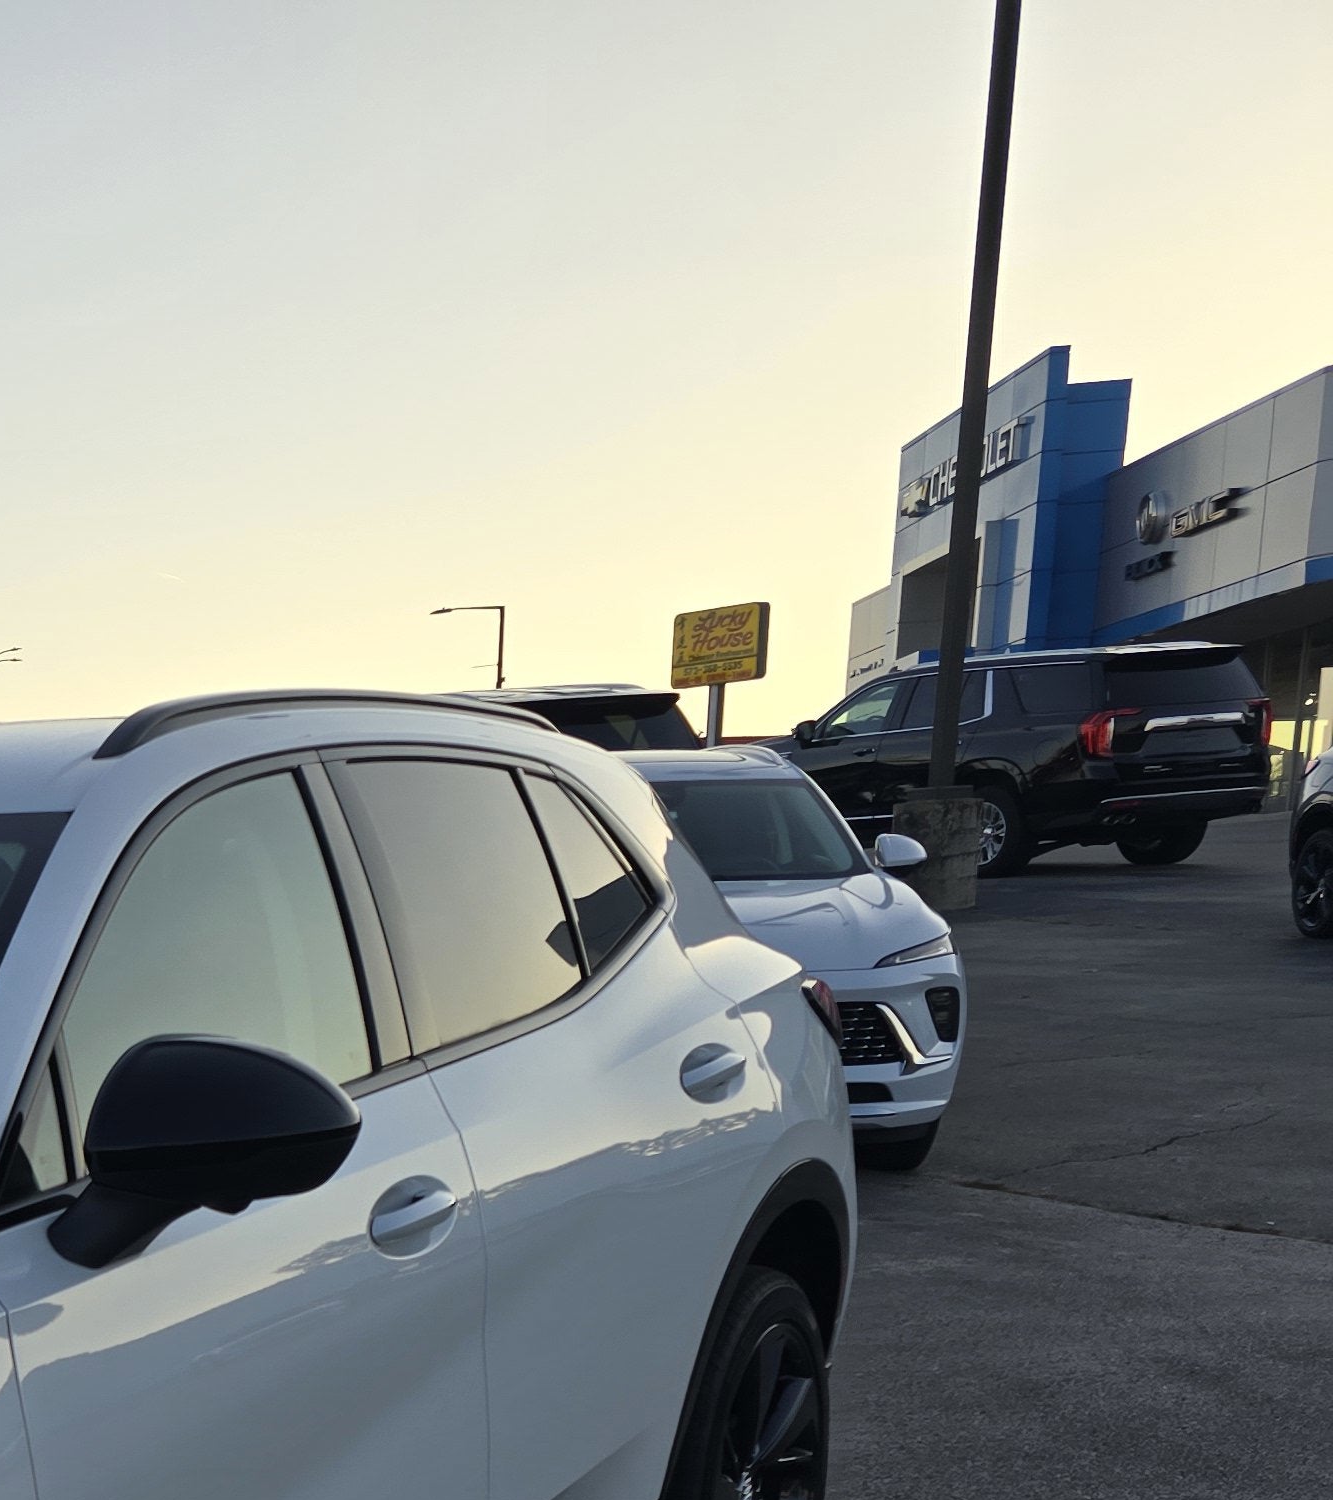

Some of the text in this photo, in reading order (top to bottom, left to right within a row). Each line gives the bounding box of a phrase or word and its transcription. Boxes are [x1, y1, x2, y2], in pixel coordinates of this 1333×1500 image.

[929, 418, 1020, 507] CHEOLET
[1170, 489, 1231, 538] GMC
[693, 609, 753, 633] Lucky
